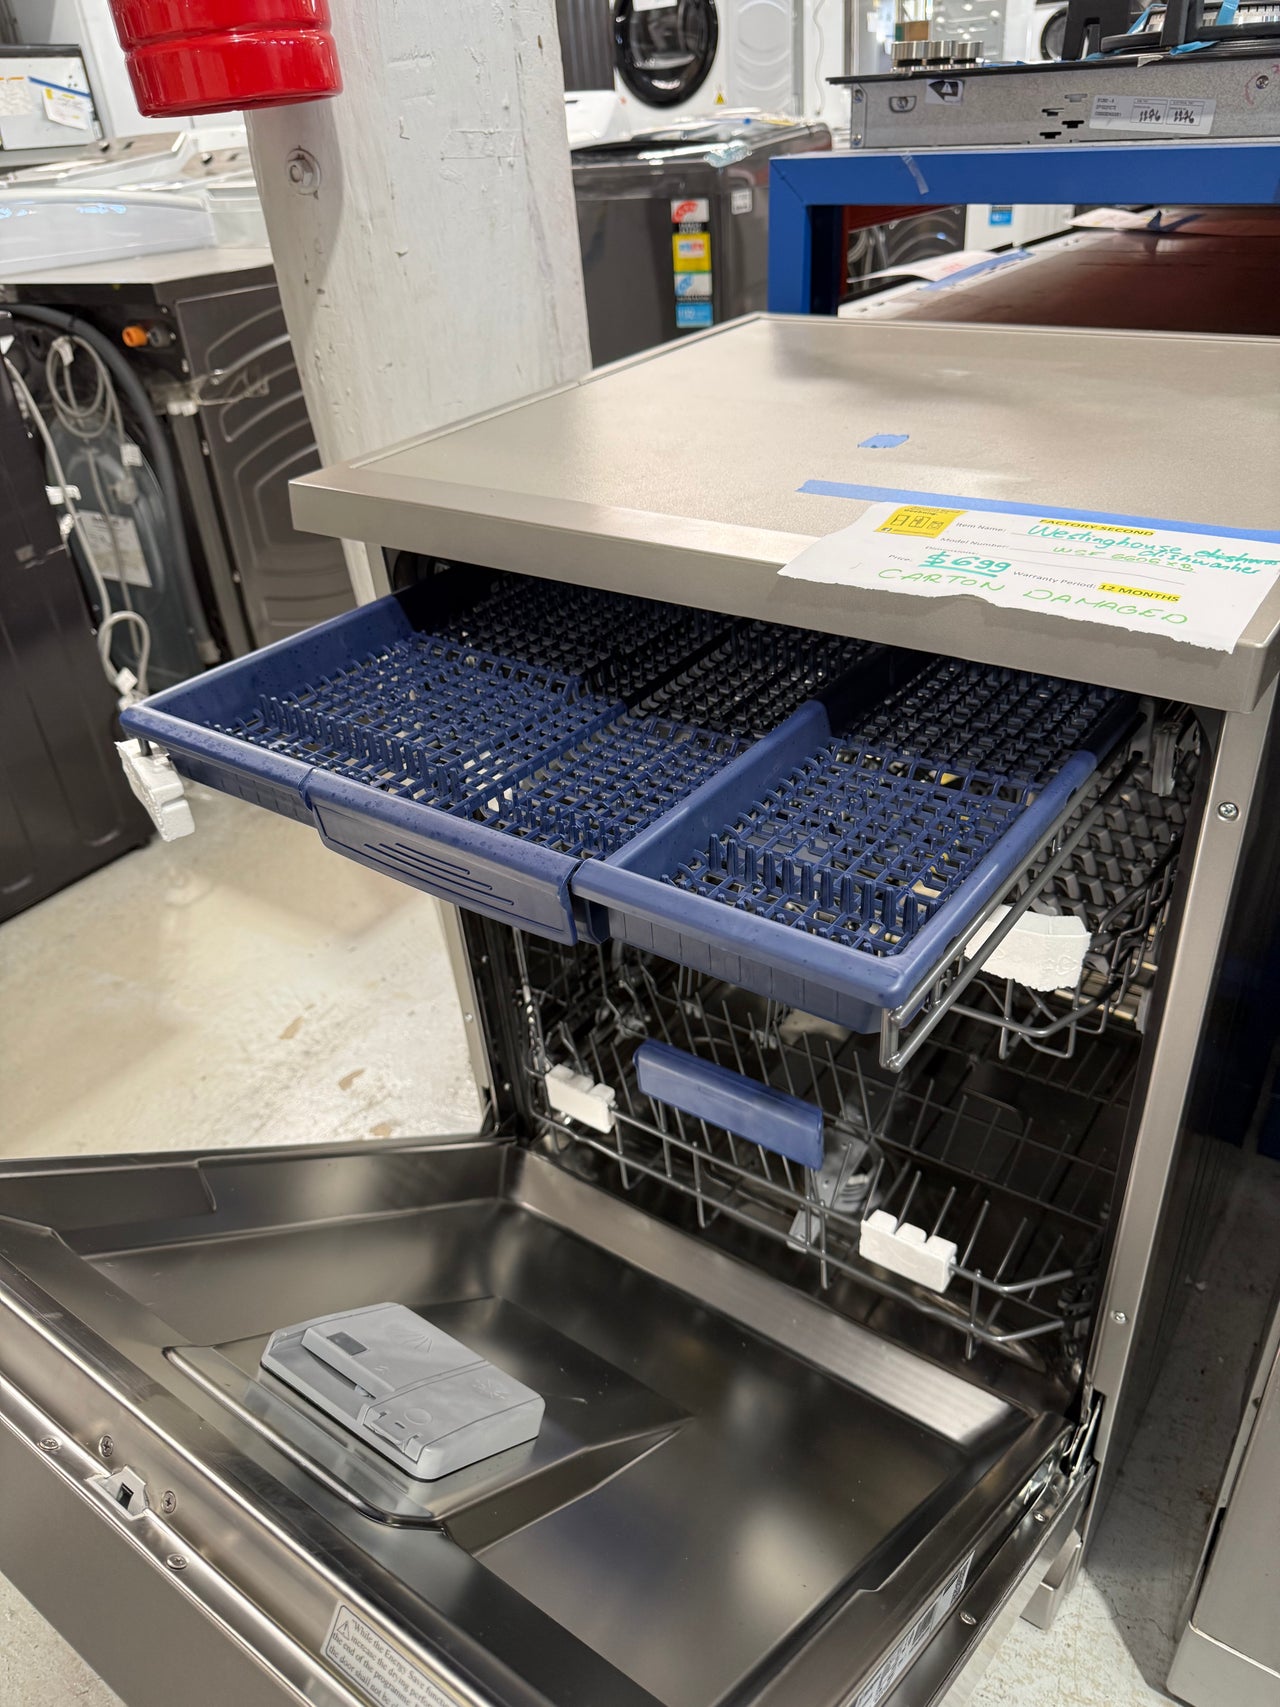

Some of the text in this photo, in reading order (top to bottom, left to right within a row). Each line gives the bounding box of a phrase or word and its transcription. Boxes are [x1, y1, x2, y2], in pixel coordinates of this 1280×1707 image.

[940, 536, 969, 546] Model
[955, 521, 1007, 533] Item Name:
[1027, 524, 1182, 555] Westinghouse
[1039, 519, 1154, 536] FACTORY SECOND
[923, 551, 1012, 573] $699
[878, 568, 1188, 624] CARTON DAMAGED
[1013, 571, 1181, 602] Warranty Period: 12 MONTHS
[329, 1645, 340, 1659] the
[340, 1655, 354, 1673] door
[355, 1669, 370, 1687] shall
[370, 1681, 382, 1696] not
[343, 1642, 355, 1657] end
[363, 1660, 375, 1674] the
[351, 1635, 377, 1661] increase
[377, 1656, 389, 1671] the
[388, 1667, 410, 1693] drying
[373, 1638, 384, 1654] the
[384, 1650, 407, 1676] Energy
[408, 1669, 425, 1690] Save
